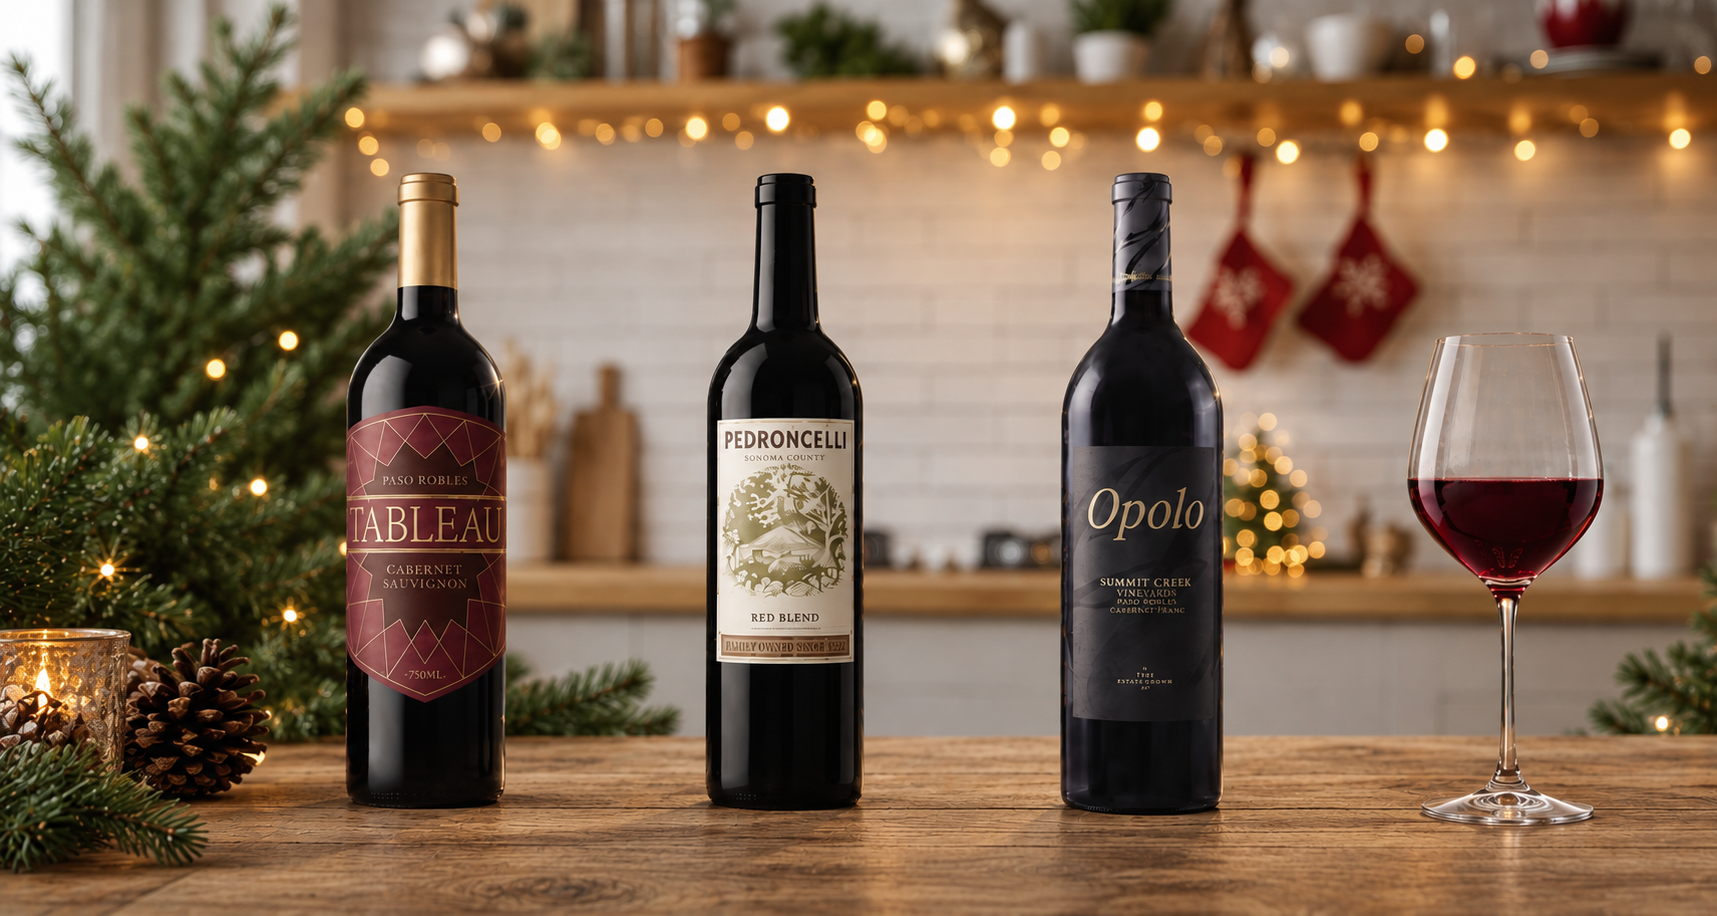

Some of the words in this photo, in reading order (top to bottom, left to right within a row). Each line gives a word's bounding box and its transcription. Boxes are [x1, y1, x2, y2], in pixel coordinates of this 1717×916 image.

[725, 430, 846, 449] PEDRONCELLI
[744, 454, 784, 462] SONOMA
[786, 454, 825, 462] COUNTY
[382, 475, 414, 486] PASO
[418, 475, 468, 486] ROBLES
[1087, 487, 1204, 541] Opolo
[350, 506, 502, 543] TABLEAU
[386, 564, 463, 575] CABERNET
[383, 578, 468, 589] SAUVIGNON
[1100, 578, 1150, 587] SUMMIT
[1153, 578, 1191, 587] CREEK
[1116, 589, 1177, 598] VINEYARDS
[751, 613, 775, 622] RED
[779, 613, 820, 622] BLEND
